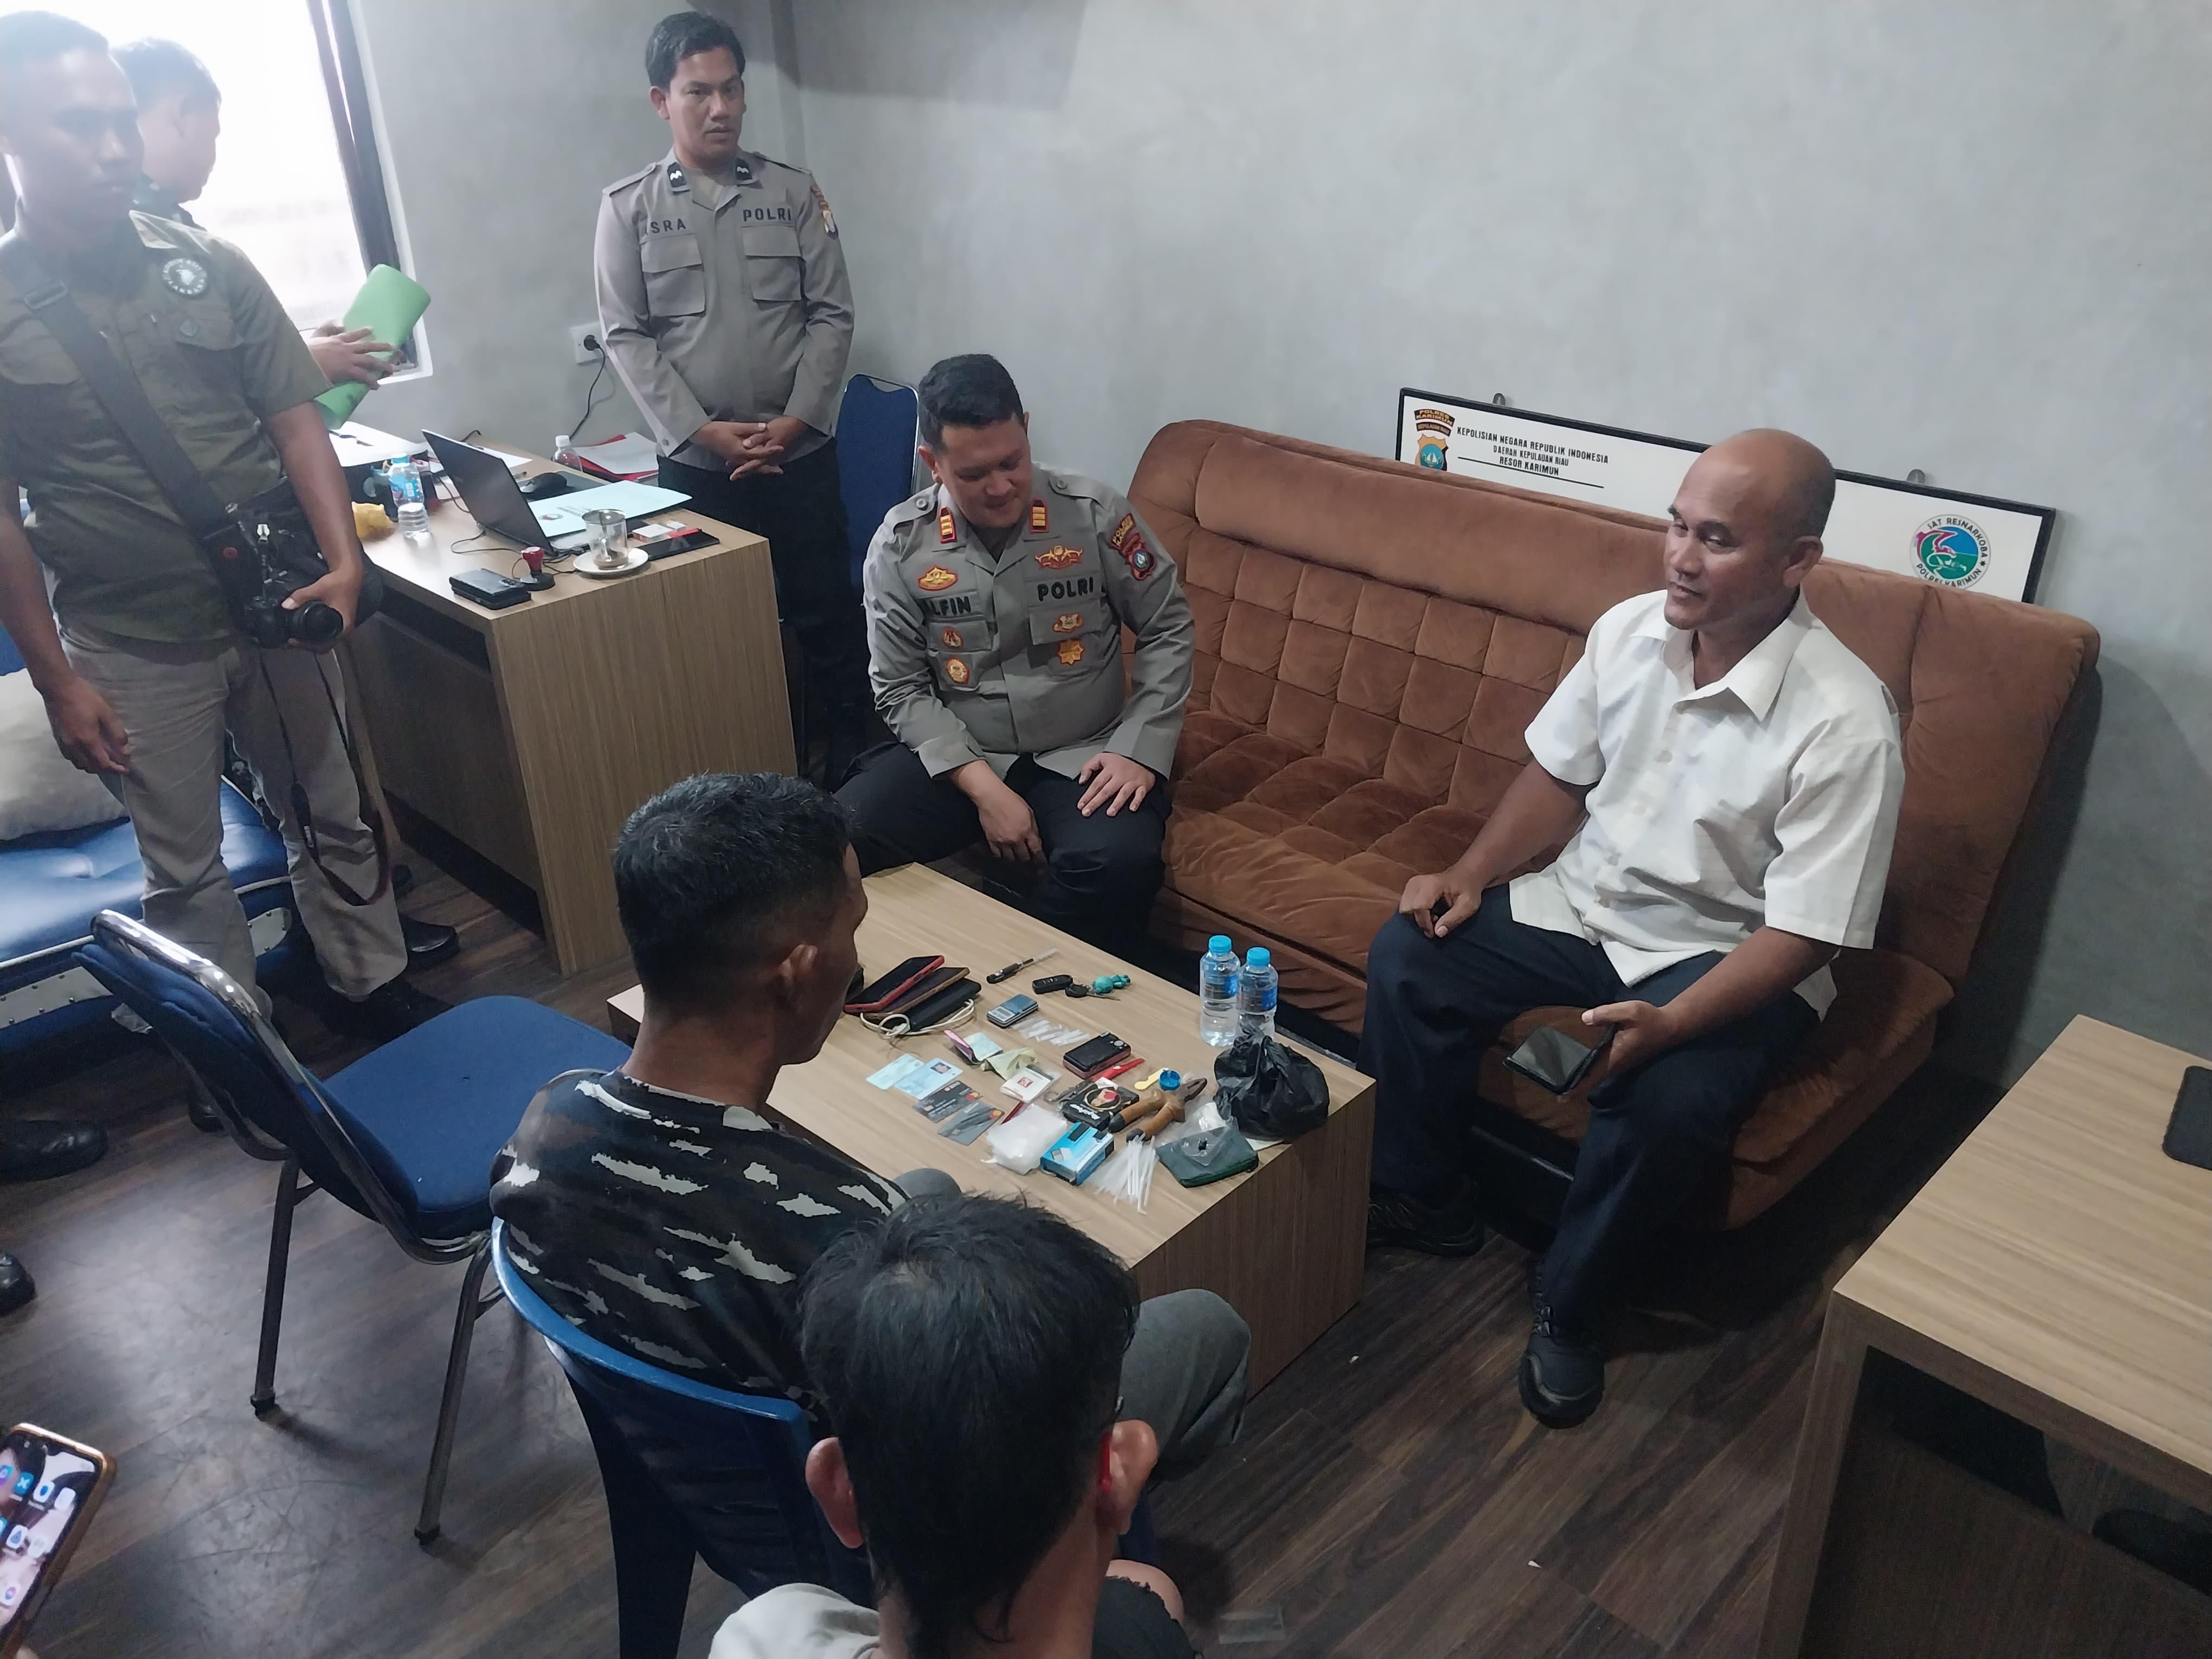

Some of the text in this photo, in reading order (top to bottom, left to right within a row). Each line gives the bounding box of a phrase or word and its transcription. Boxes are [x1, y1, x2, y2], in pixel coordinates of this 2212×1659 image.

[743, 208, 792, 222] POLRI
[1416, 414, 1452, 426] KARIMUN
[1419, 409, 1450, 419] POLRES
[1457, 426, 1609, 464] KEPOLISIAN NEGARA REPUBLIK INDONESIA
[1493, 445, 1569, 466] DAERAH KEPULAUAN RIAU
[1499, 456, 1559, 476] RESOR KARIMUN
[1927, 517, 1988, 558] SAT RESNARKOBA
[1038, 577, 1094, 601] POLRI
